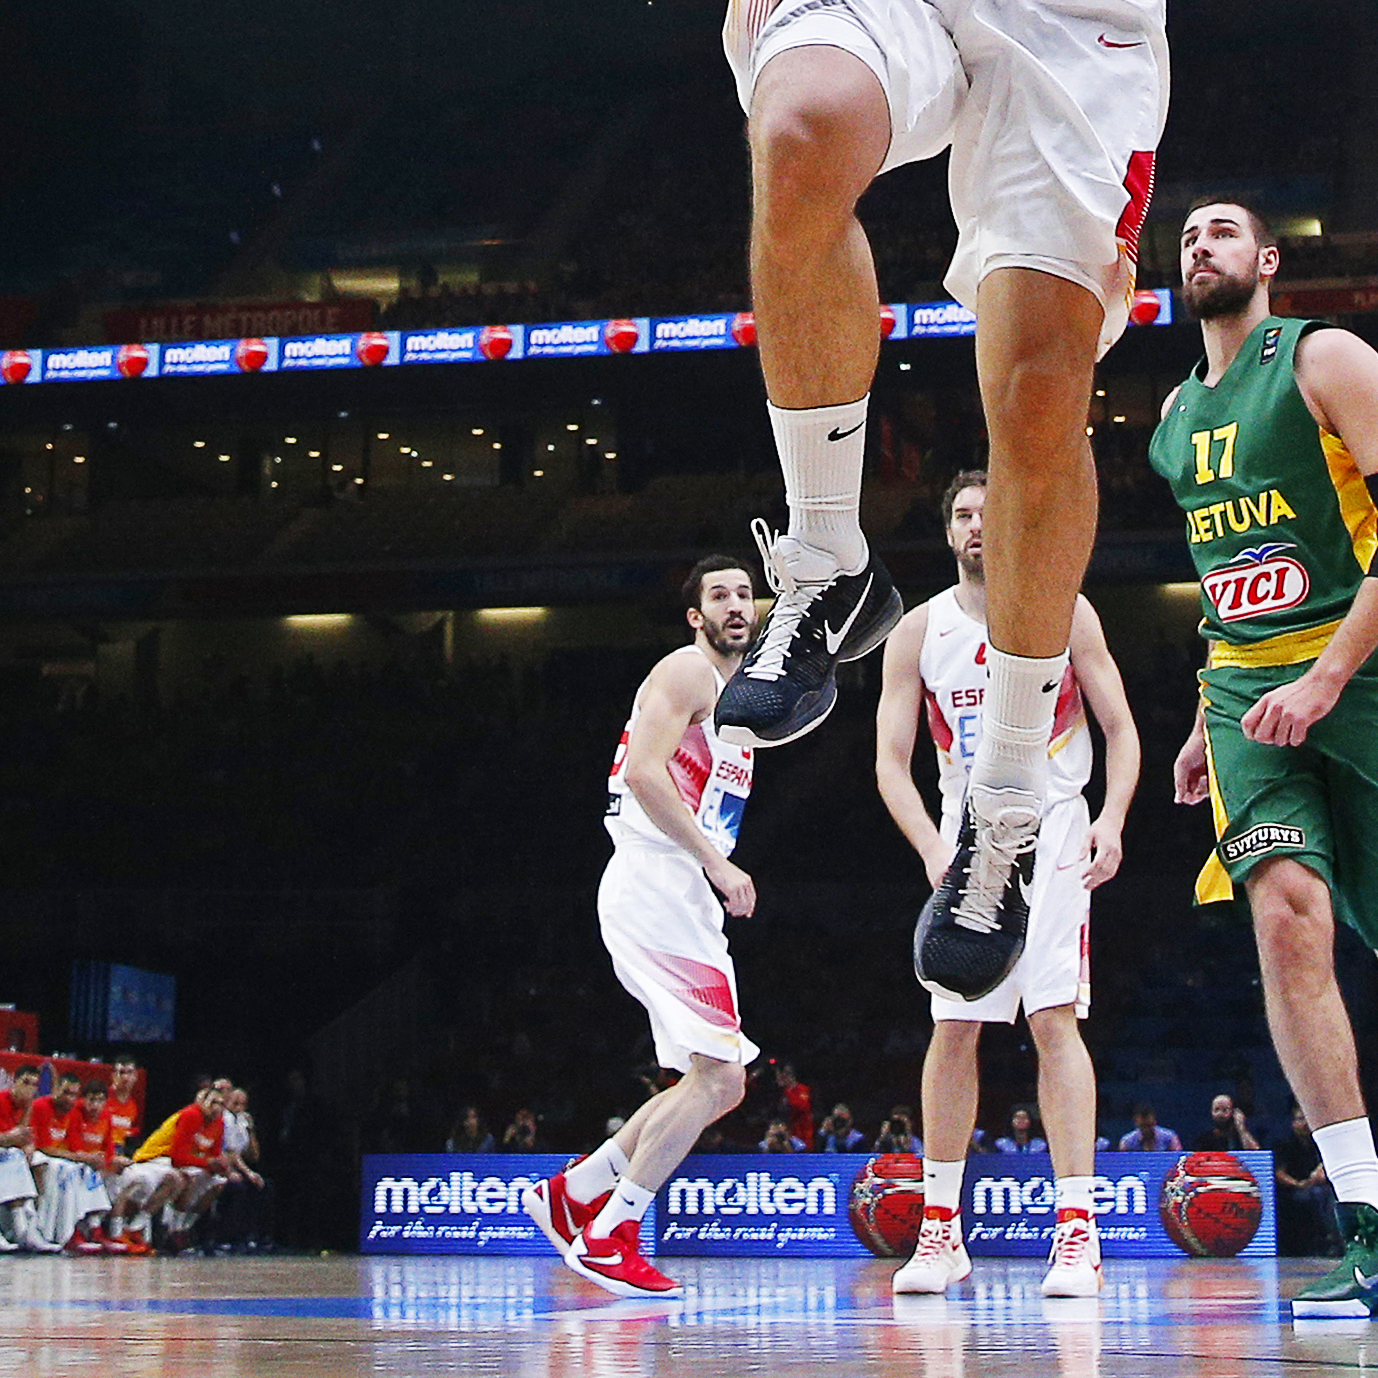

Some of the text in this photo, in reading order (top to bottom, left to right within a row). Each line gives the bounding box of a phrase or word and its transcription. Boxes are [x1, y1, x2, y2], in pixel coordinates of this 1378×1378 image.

[529, 325, 598, 346] molten
[655, 319, 725, 339] molten
[284, 338, 351, 358] molten
[406, 332, 474, 352] molten
[47, 350, 112, 370] molten
[165, 343, 230, 364] molten
[1191, 422, 1237, 484] 17
[1210, 566, 1289, 611] VICI
[668, 1172, 836, 1215] molten
